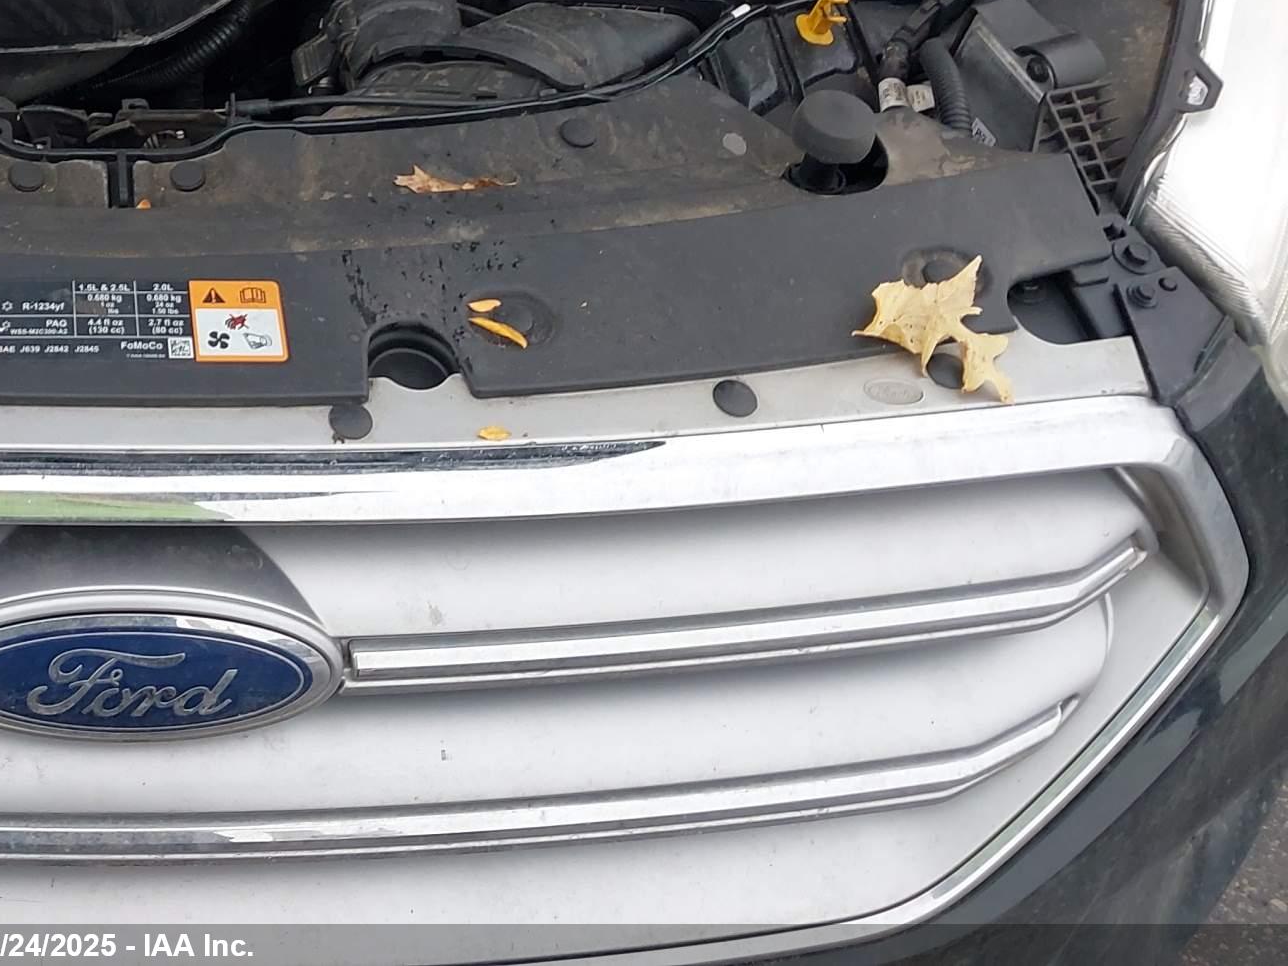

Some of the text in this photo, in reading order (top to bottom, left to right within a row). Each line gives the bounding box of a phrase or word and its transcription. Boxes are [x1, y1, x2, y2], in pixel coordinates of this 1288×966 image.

[100, 283, 109, 292] &
[152, 283, 174, 292] 2.0L
[87, 293, 123, 304] 0.680 kg
[146, 293, 182, 304] 0.680 kg
[22, 302, 65, 312] R-1234yf
[87, 318, 102, 326] 4.4
[112, 319, 124, 327] oz
[148, 318, 162, 326] 2.7
[172, 319, 185, 327] oz
[110, 326, 125, 335] cc)
[168, 326, 184, 335] cc)
[120, 341, 164, 351] FoMoCo
[26, 647, 238, 718] Ford
